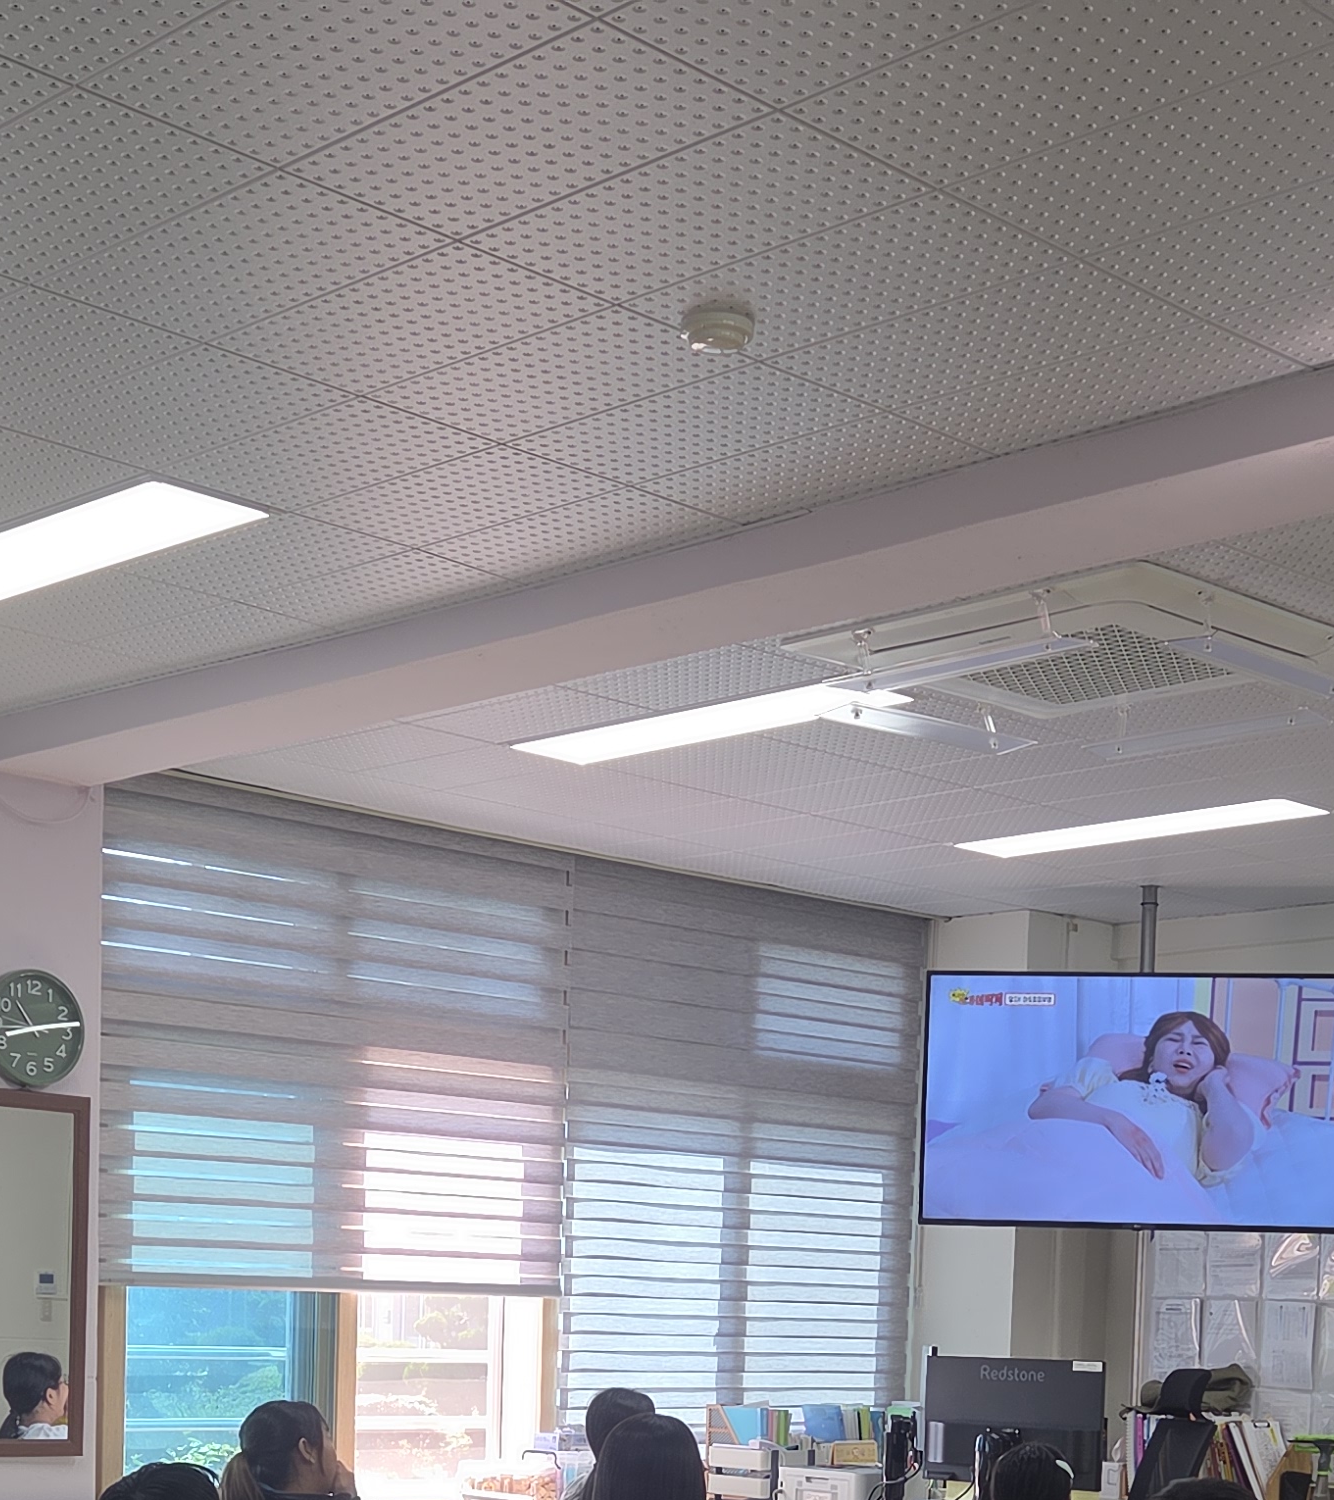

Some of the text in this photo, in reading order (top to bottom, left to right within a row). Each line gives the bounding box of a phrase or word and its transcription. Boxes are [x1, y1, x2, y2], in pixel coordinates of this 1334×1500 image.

[9, 981, 22, 998] 11
[26, 979, 42, 996] 12
[47, 988, 53, 1003] 1
[57, 1006, 68, 1020] 2
[62, 1027, 72, 1040] 3
[56, 1044, 67, 1058] 4
[9, 1052, 22, 1068] 7
[43, 1057, 55, 1072] 5
[26, 1061, 38, 1076] 6
[980, 1364, 1045, 1382] Redstone
